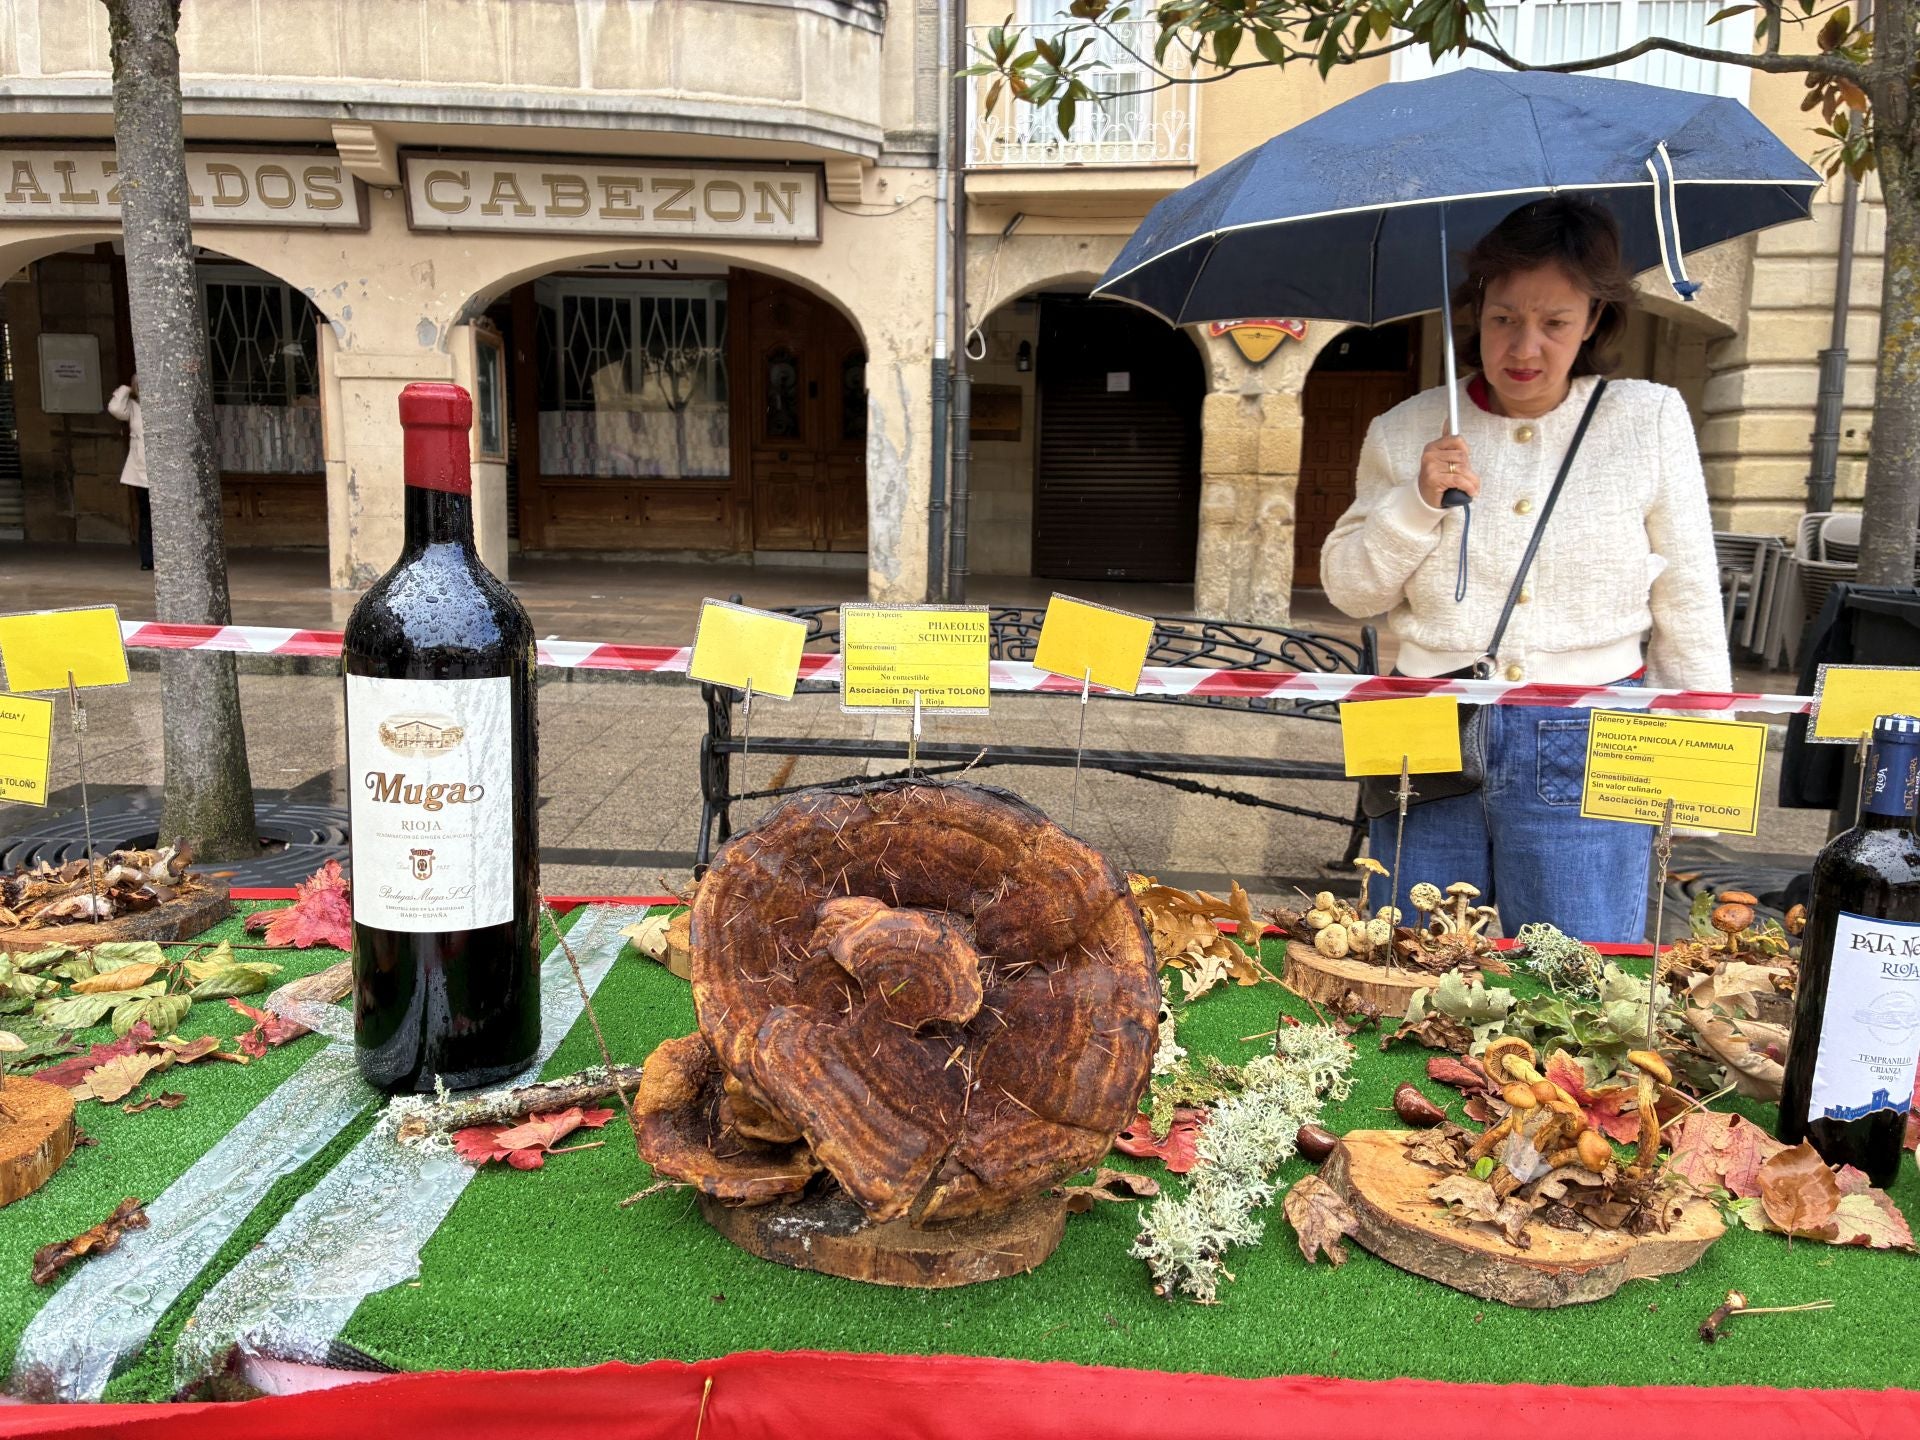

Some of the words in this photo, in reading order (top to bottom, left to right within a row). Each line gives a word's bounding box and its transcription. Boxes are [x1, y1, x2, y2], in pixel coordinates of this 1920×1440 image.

[4, 160, 344, 210] ALDOS
[423, 169, 802, 225] CABEZON
[928, 621, 985, 631] PHAEOLUS
[918, 634, 987, 644] SCHWINITZII
[847, 664, 896, 672] Comestibilidad:
[880, 673, 891, 681] No
[849, 686, 900, 694] Asociación
[948, 687, 986, 695] TOLOÑO
[925, 698, 945, 706] Rioja
[1596, 715, 1625, 724] Género
[1633, 718, 1668, 728] Especie:
[1596, 731, 1638, 742] PHOLIOTA
[1639, 735, 1678, 746] PINICOLA
[1678, 738, 1684, 748] /
[1685, 740, 1735, 751] FLAMMULA
[1592, 750, 1624, 760] Nombre
[1625, 754, 1655, 763] común:
[4, 777, 36, 789] TOLOÑO
[1590, 771, 1651, 784] Comestibilidad:
[1874, 767, 1888, 793] RIOJA
[365, 771, 485, 812] Muga
[1592, 780, 1605, 789] Sin
[1606, 783, 1626, 791] valor
[1627, 784, 1662, 795] culinario
[1598, 794, 1649, 807] Asociación
[1651, 799, 1696, 812] Deprtiva
[1698, 804, 1741, 816] TOLOÑO
[1634, 807, 1660, 818] Haro,
[1675, 812, 1700, 822] Rioja
[401, 820, 443, 832] RIOJA
[379, 885, 414, 903] Bodegas
[414, 887, 444, 904] Muga
[1850, 932, 1897, 956] PATA
[1881, 961, 1920, 978] RIOJA
[1858, 1053, 1912, 1065] TEMPRANILLO
[1869, 1065, 1902, 1075] CRIANZA
